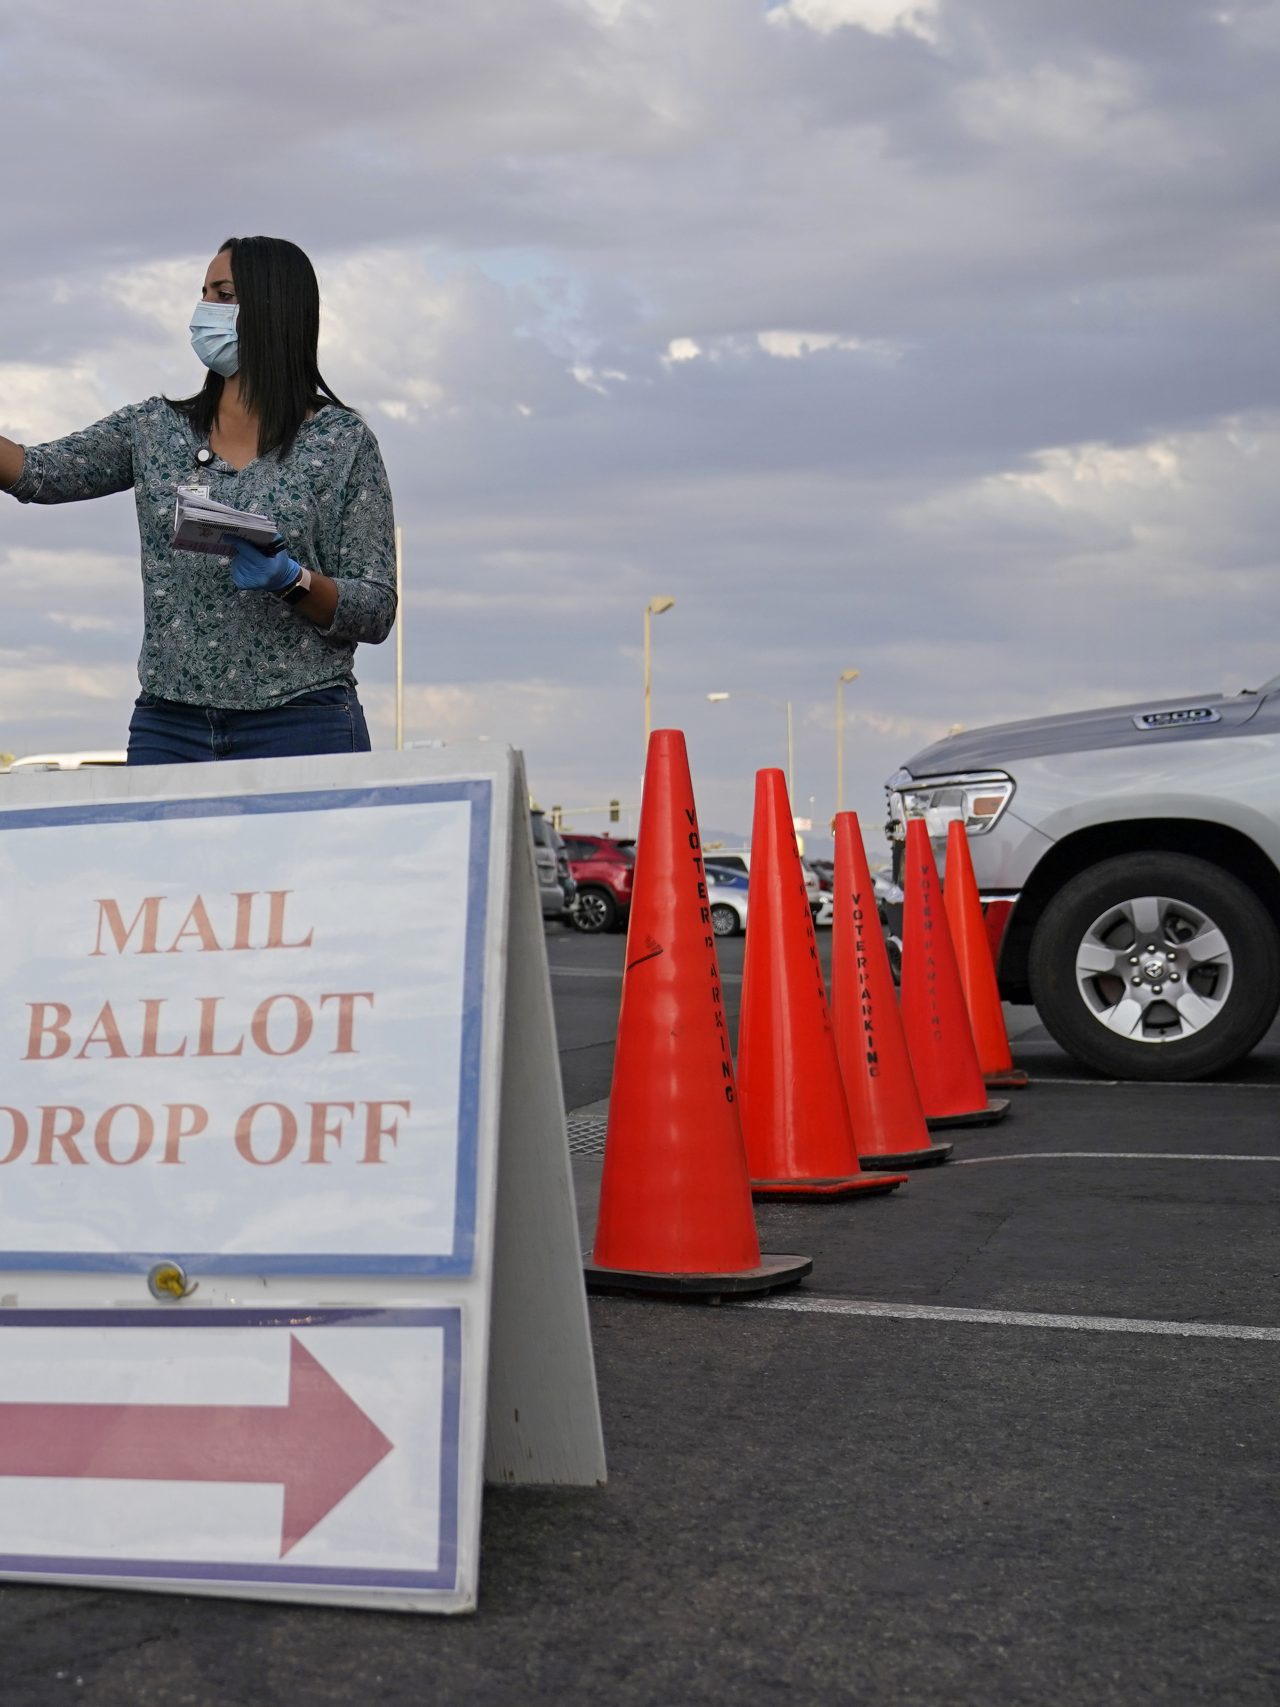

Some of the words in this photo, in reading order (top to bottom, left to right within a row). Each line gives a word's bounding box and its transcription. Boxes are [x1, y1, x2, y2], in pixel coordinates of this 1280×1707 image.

[88, 889, 316, 956] MAIL
[685, 808, 711, 924] VOTER
[704, 936, 734, 1103] PARKING
[20, 991, 375, 1061] BALLOT
[233, 1099, 412, 1166] OFF
